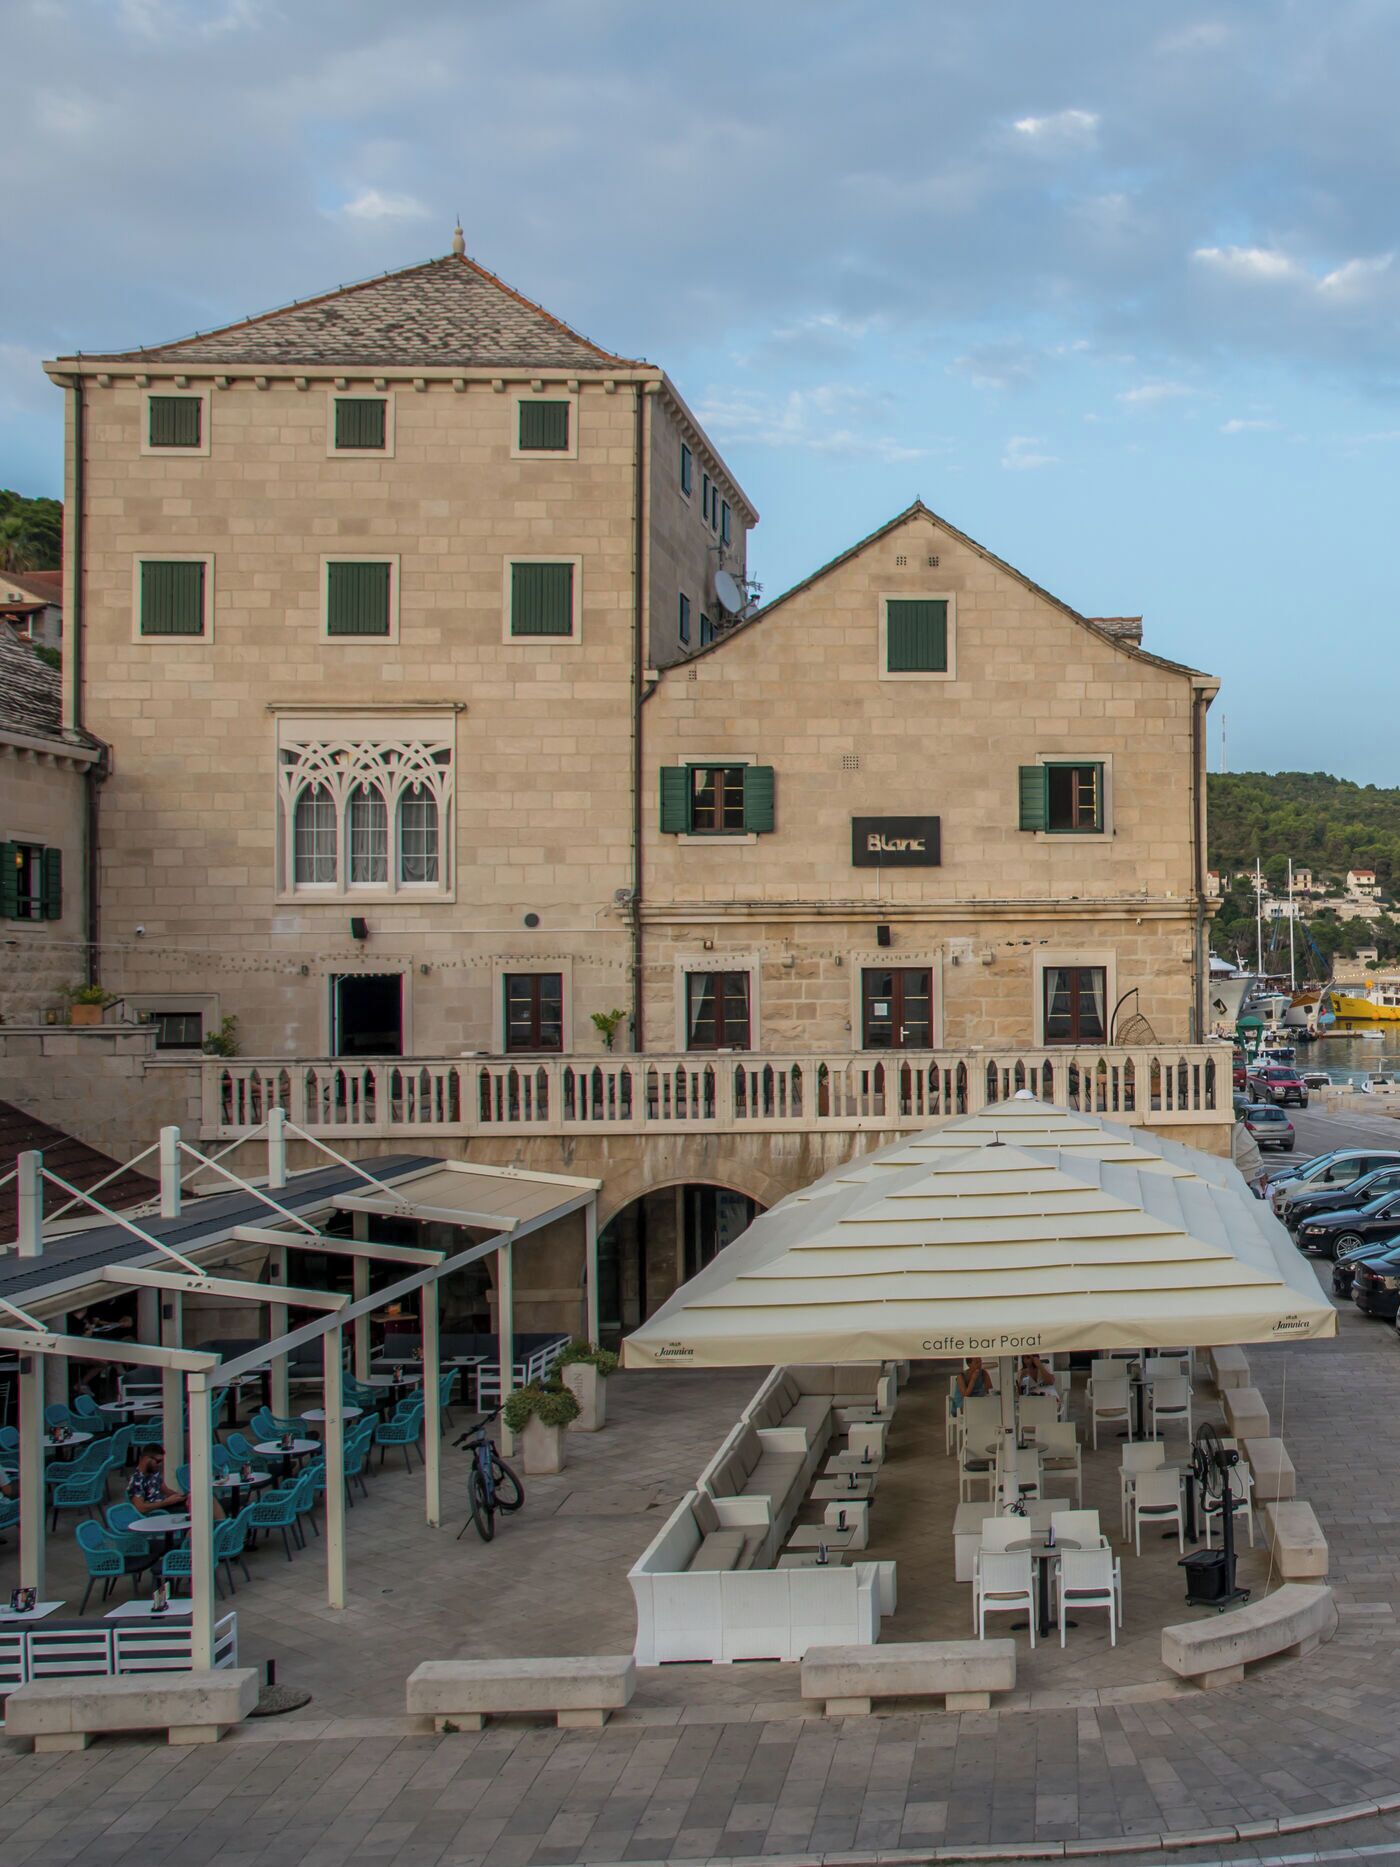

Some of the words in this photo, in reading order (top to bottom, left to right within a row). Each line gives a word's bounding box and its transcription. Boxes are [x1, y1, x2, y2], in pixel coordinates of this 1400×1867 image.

[867, 833, 926, 851] Blanc
[922, 1337, 965, 1350] caffe
[969, 1336, 997, 1349] bar
[1000, 1333, 1042, 1347] Porat
